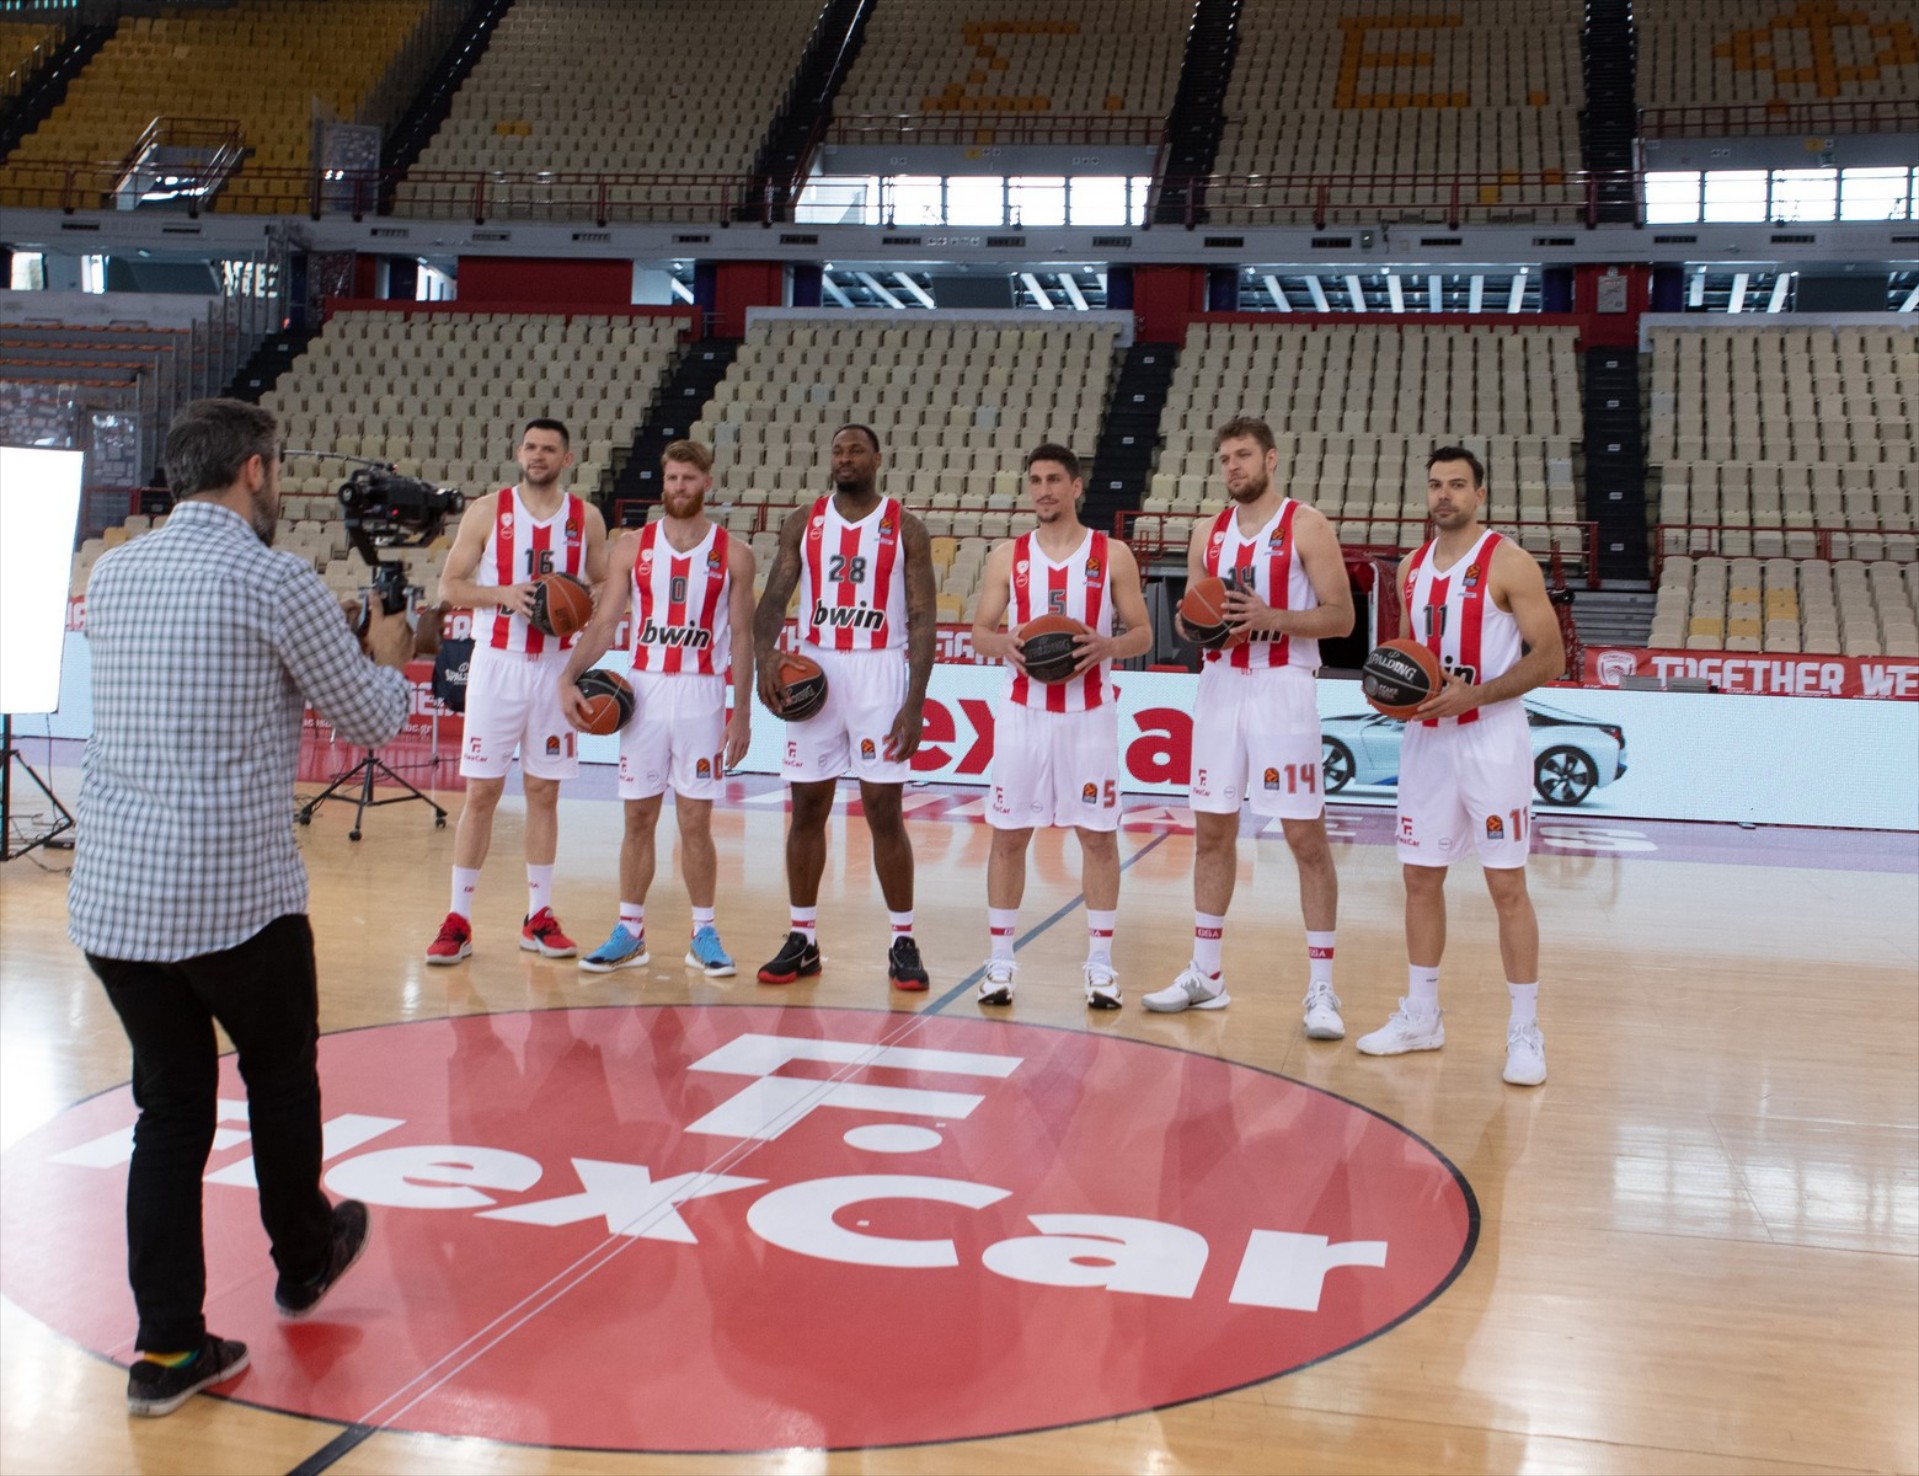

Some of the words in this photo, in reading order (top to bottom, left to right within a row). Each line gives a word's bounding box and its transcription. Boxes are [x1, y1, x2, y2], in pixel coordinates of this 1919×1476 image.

[524, 548, 555, 576] 16
[828, 554, 867, 584] 28
[1228, 565, 1257, 590] 14
[671, 575, 688, 604] 0
[1048, 588, 1067, 616] 5
[812, 597, 886, 632] bwin
[1423, 604, 1449, 638] 11
[639, 616, 711, 650] bwin
[1366, 652, 1417, 681] SPALDING
[1442, 654, 1477, 688] in
[1651, 656, 1845, 696] TOGETHER
[1104, 780, 1116, 809] 5
[1284, 763, 1316, 795] 14
[1509, 806, 1529, 843] 11
